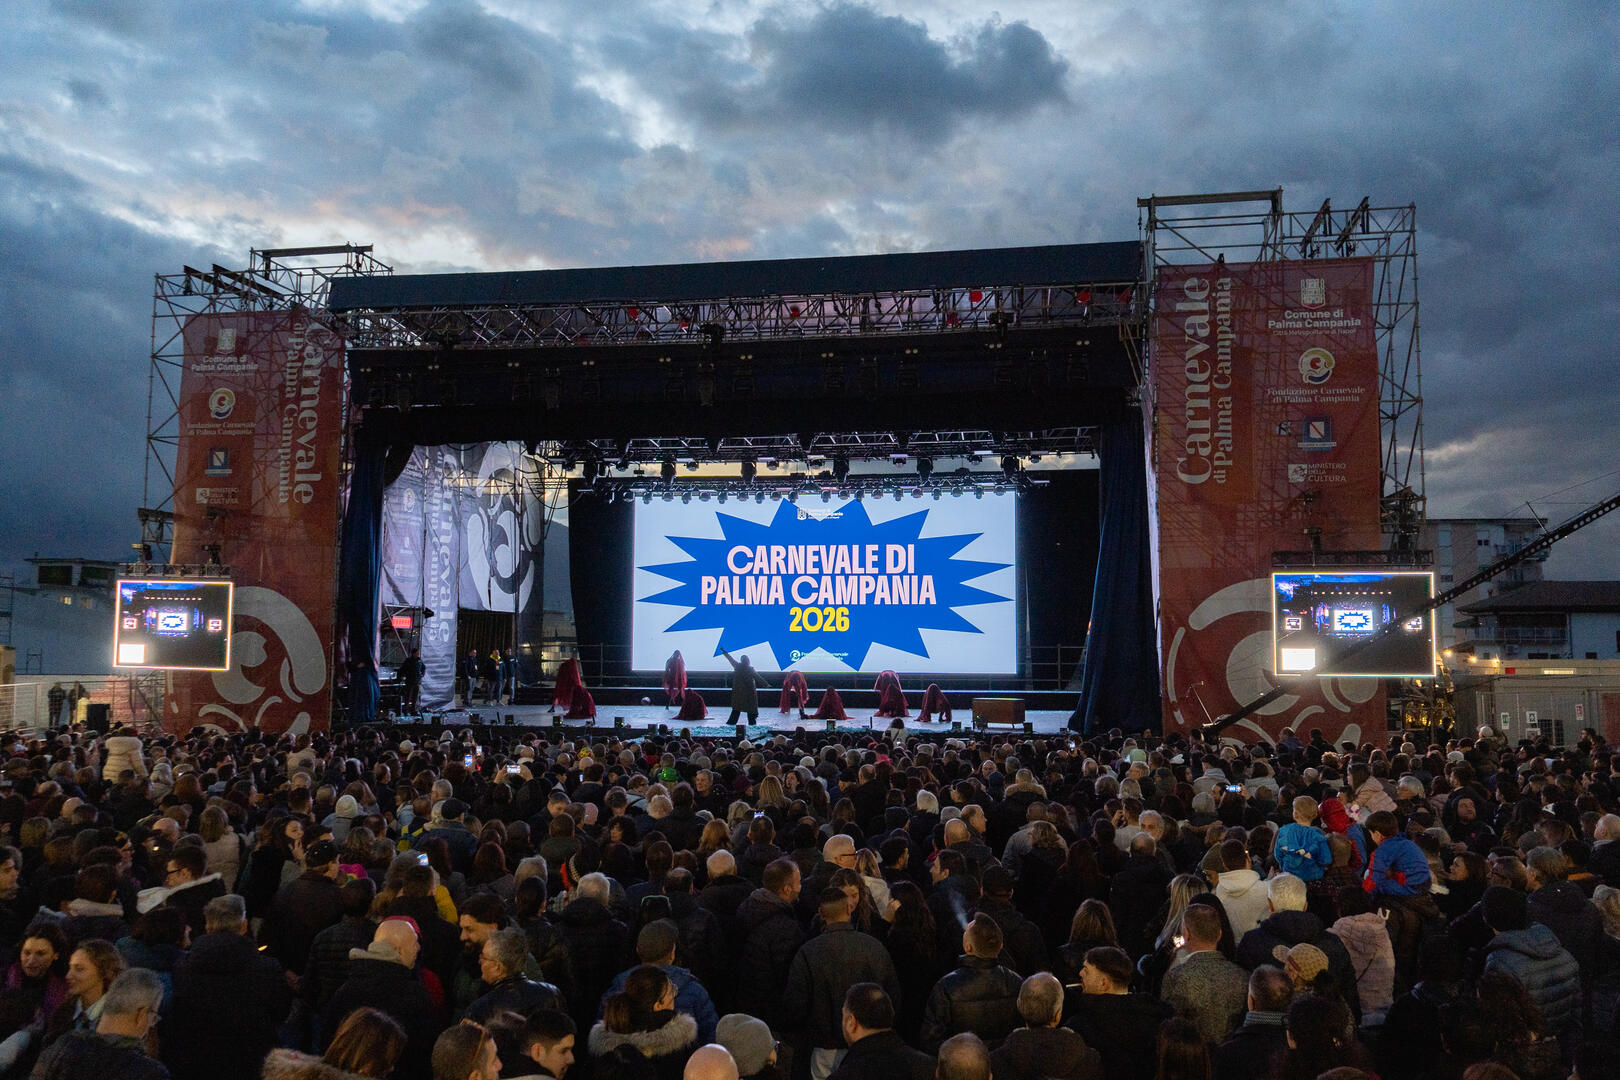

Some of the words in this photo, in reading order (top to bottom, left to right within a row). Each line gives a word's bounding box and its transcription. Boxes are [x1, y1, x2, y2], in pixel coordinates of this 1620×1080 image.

[1268, 320, 1303, 329] Palma
[1304, 317, 1361, 329] Campania
[1284, 309, 1331, 319] Comune
[1333, 308, 1344, 318] di
[1212, 277, 1236, 390] Campania
[285, 337, 304, 398] Palma
[1175, 277, 1212, 485] Carnevale
[1320, 386, 1365, 395] Carnevale
[292, 321, 334, 505] Carnevale
[1213, 396, 1233, 467] Palma
[278, 402, 299, 503] Campania
[1213, 469, 1227, 484] di
[727, 544, 879, 575] CARNEVALE
[885, 543, 915, 574] DI
[700, 575, 786, 605] PALMA
[790, 574, 937, 605] CAMPANIA
[789, 606, 850, 632] 2026
